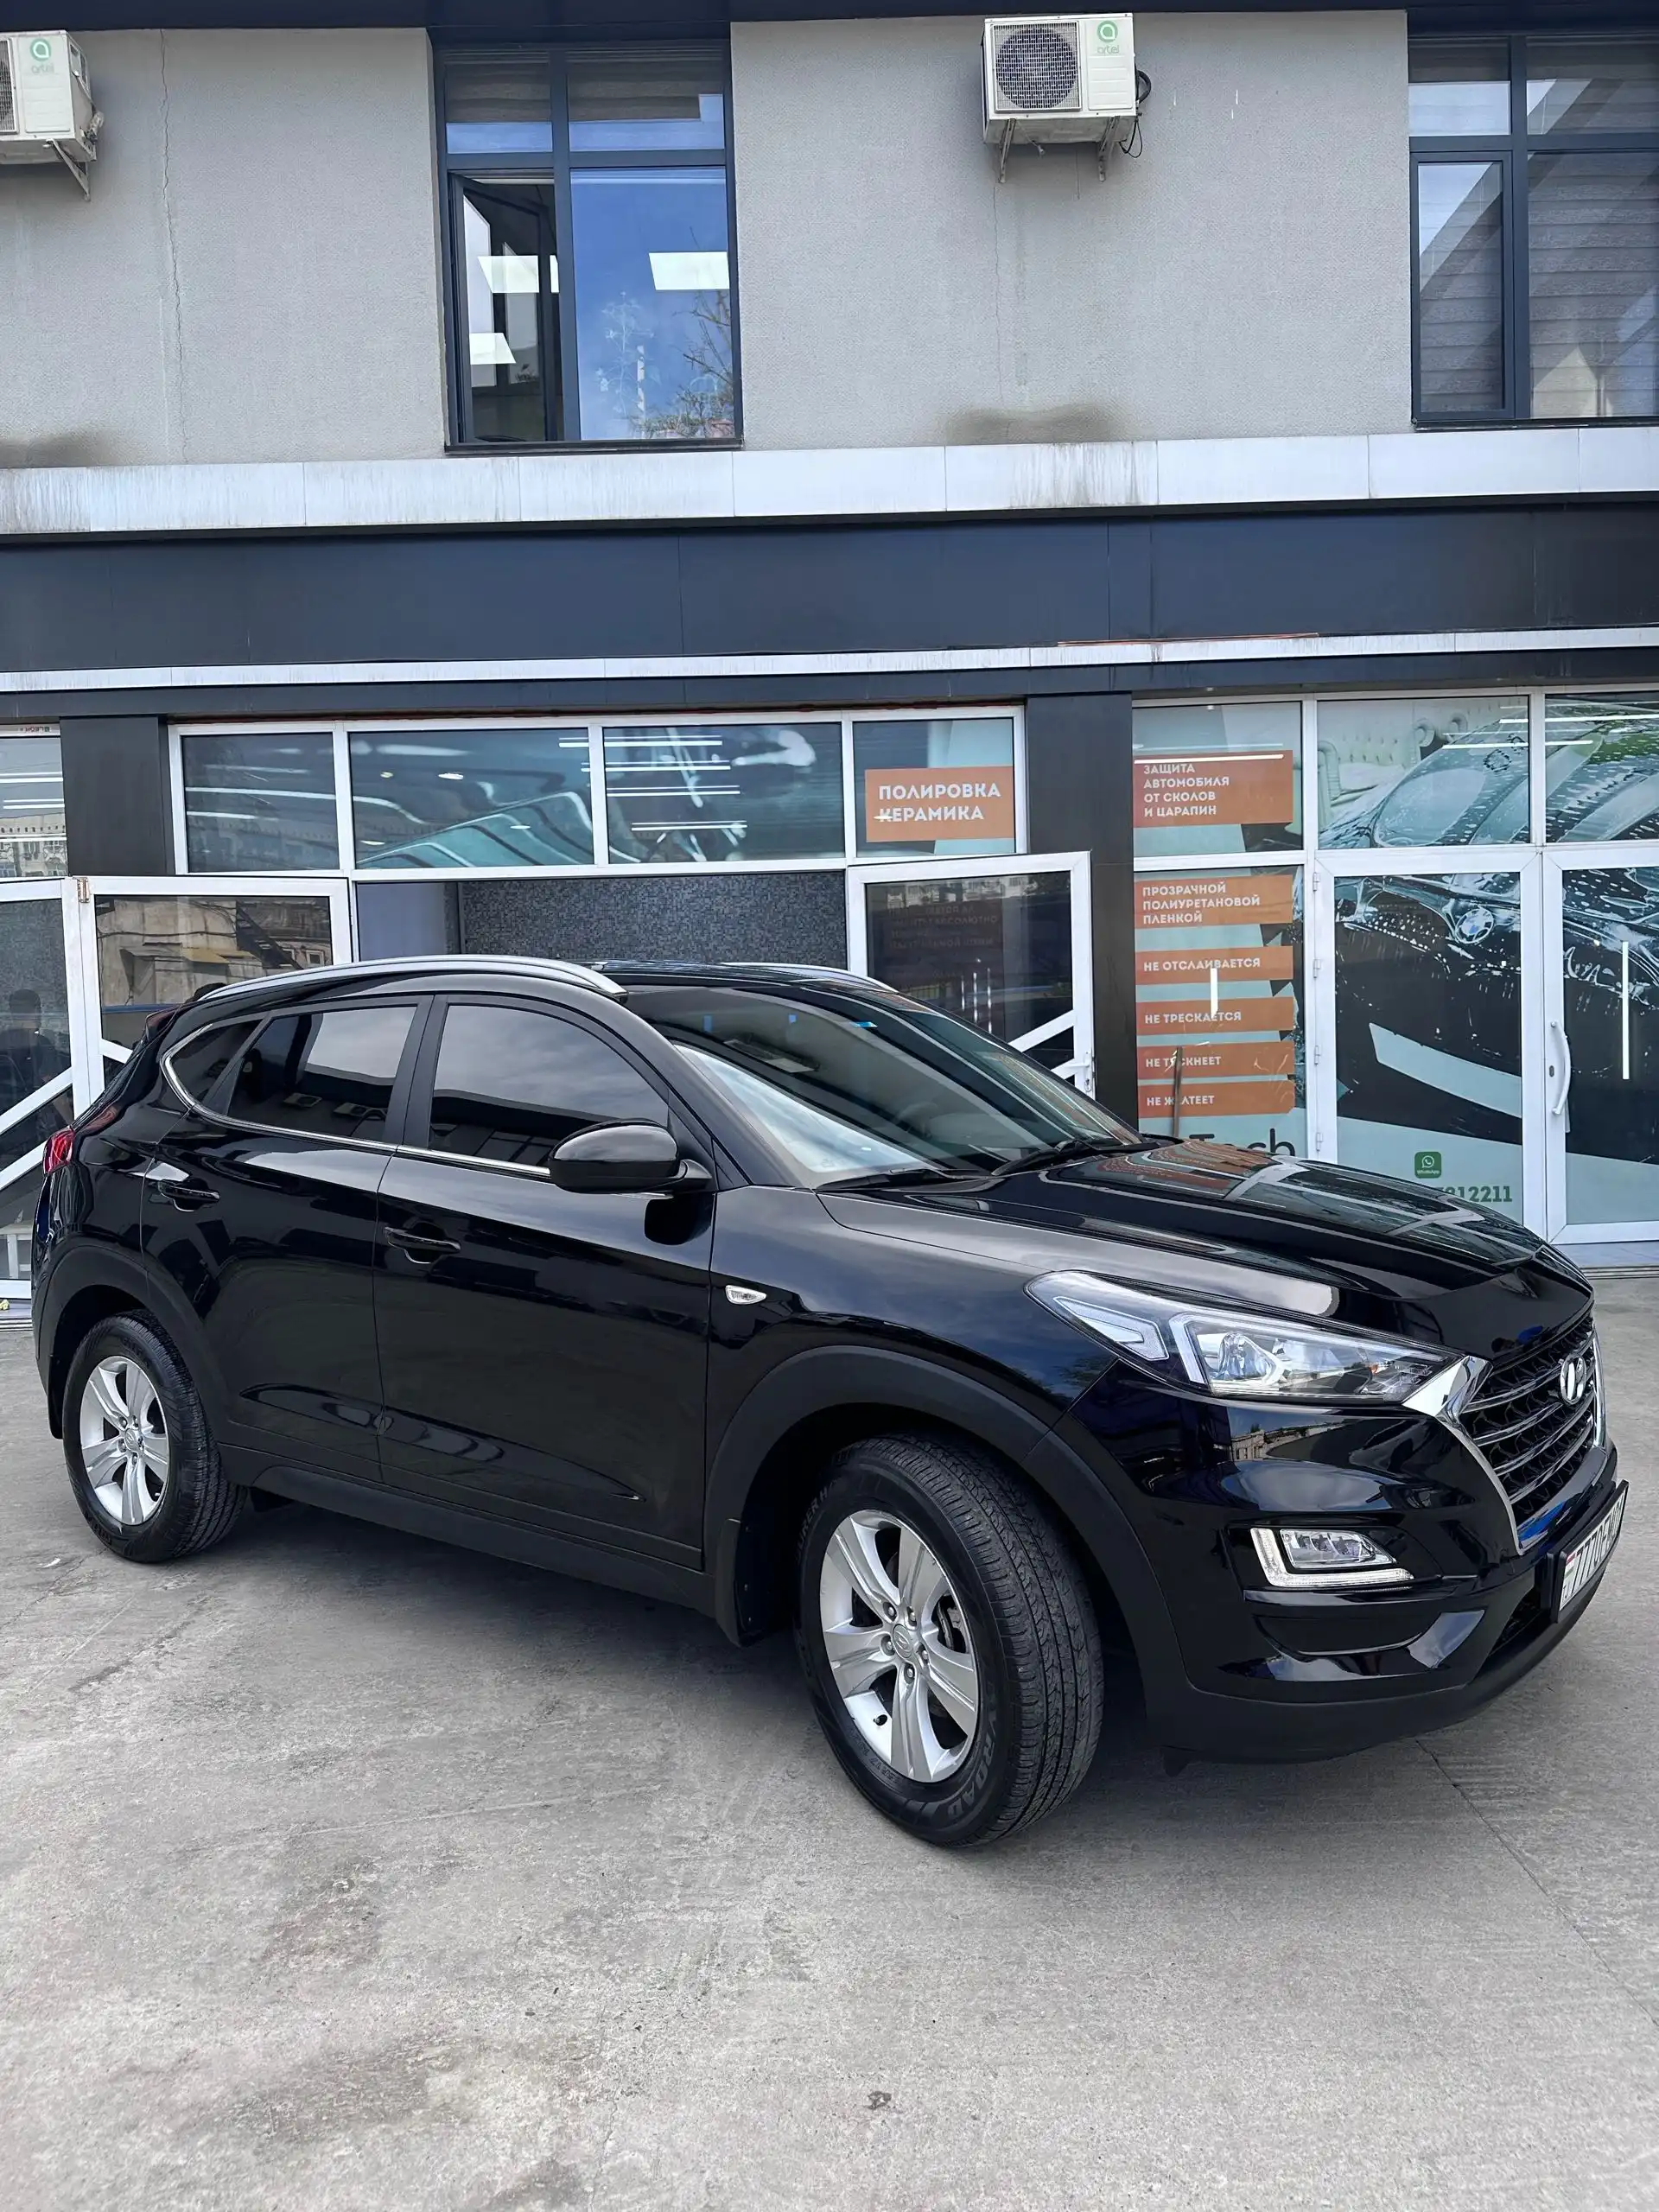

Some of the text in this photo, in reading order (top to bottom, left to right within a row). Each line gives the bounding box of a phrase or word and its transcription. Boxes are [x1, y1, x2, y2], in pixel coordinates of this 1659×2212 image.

[1143, 764, 1195, 775] ЗАЩИТА
[1143, 776, 1230, 789] АВТОМОБИЛЯ
[878, 782, 1001, 800] ПОЛИРОВКА
[1144, 791, 1217, 804] ОТ СКОЛОВ
[878, 805, 984, 823] КЕРАМИКА
[1144, 805, 1217, 817] И ЦАРАПИН
[1142, 881, 1226, 896] ПРОЗРАЧНОЙ
[1143, 894, 1261, 911] ПОЛИУРЕТАНОВОЙ
[1143, 911, 1202, 924] ПЛЕНКОЙ
[1144, 957, 1261, 971] НЕ ОТСЛАИВАЕТСЯ
[1145, 1012, 1242, 1024] НЕ ТРЕСКАЕТСЯ
[1146, 1058, 1160, 1067] НЕ
[1147, 1095, 1215, 1106] НЕ ЖЛТЕЕТ
[1437, 1185, 1513, 1202] 12211
